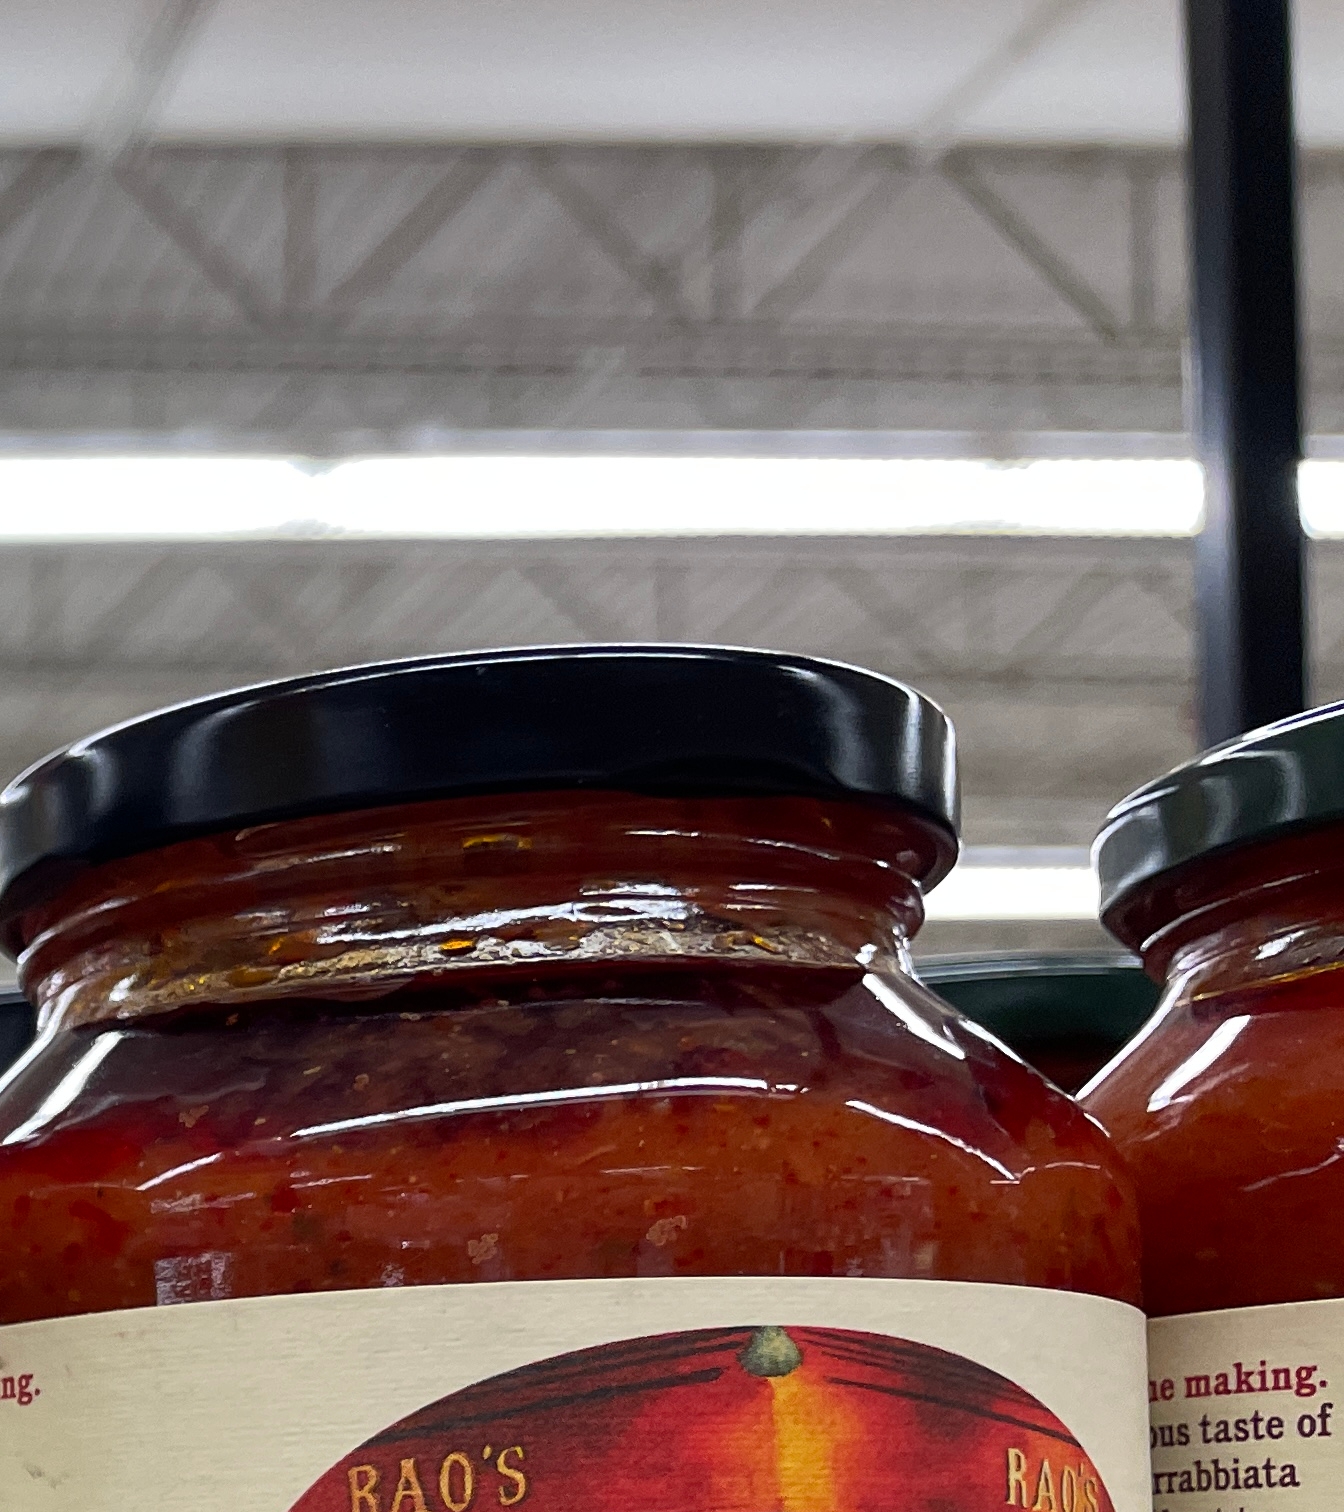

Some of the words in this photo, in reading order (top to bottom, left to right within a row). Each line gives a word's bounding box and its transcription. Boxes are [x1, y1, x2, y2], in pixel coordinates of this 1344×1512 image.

[1184, 1360, 1328, 1398] making.
[1199, 1409, 1284, 1444] taste
[1297, 1402, 1333, 1438] of
